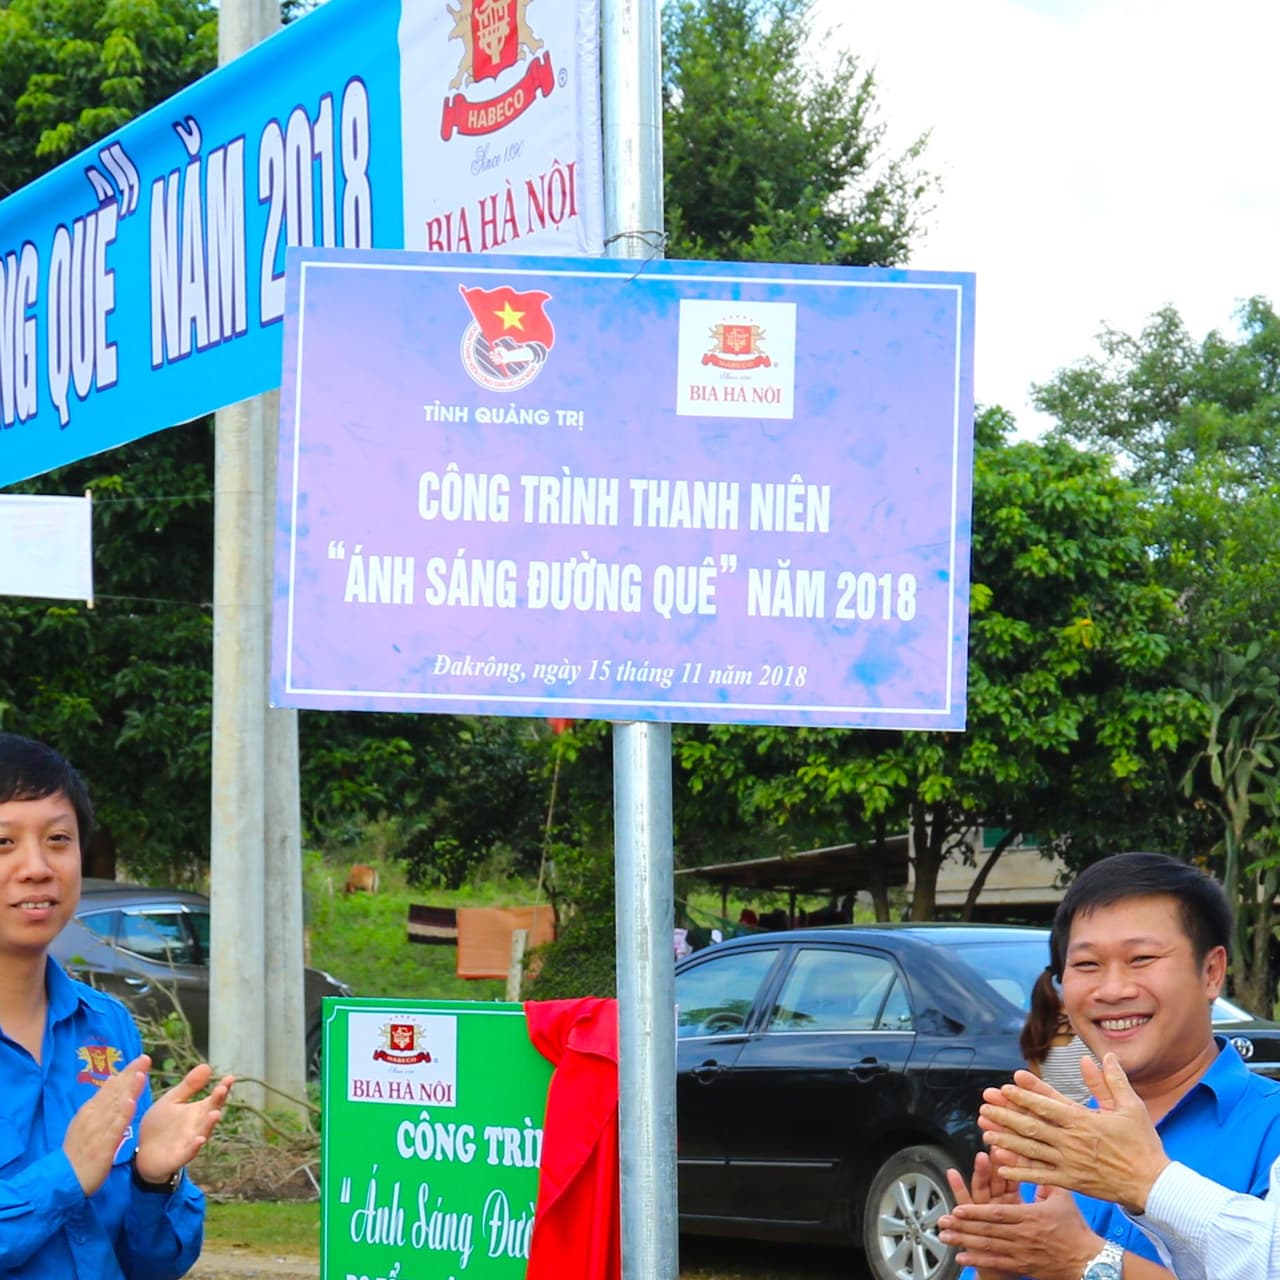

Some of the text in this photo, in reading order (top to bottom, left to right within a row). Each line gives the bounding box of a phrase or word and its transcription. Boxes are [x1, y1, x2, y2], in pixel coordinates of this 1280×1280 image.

[468, 89, 524, 129] HABECO
[149, 115, 247, 370] NĂM
[259, 77, 372, 327] 2018
[478, 178, 520, 252] HÀ
[525, 158, 578, 234] NỘI
[424, 400, 584, 431] TỈNH QUẢNG TRỊ
[689, 385, 718, 401] BIA
[723, 385, 747, 402] HÀ
[418, 462, 831, 533] CÔNG TRÌNH THANH NIÊN
[425, 548, 517, 608] SÁNG
[528, 551, 641, 612] ĐƯỜNG
[747, 560, 825, 619] NĂM
[835, 572, 917, 622] 2018
[432, 654, 808, 688] Đakrông, ngày 15 tháng 11 năm 2018
[352, 1078, 453, 1104] BIA HÀ NỘI
[396, 1110, 544, 1168] CÔNG TRÌ
[411, 1182, 474, 1270] Sáng
[482, 1189, 536, 1260] Đườ
